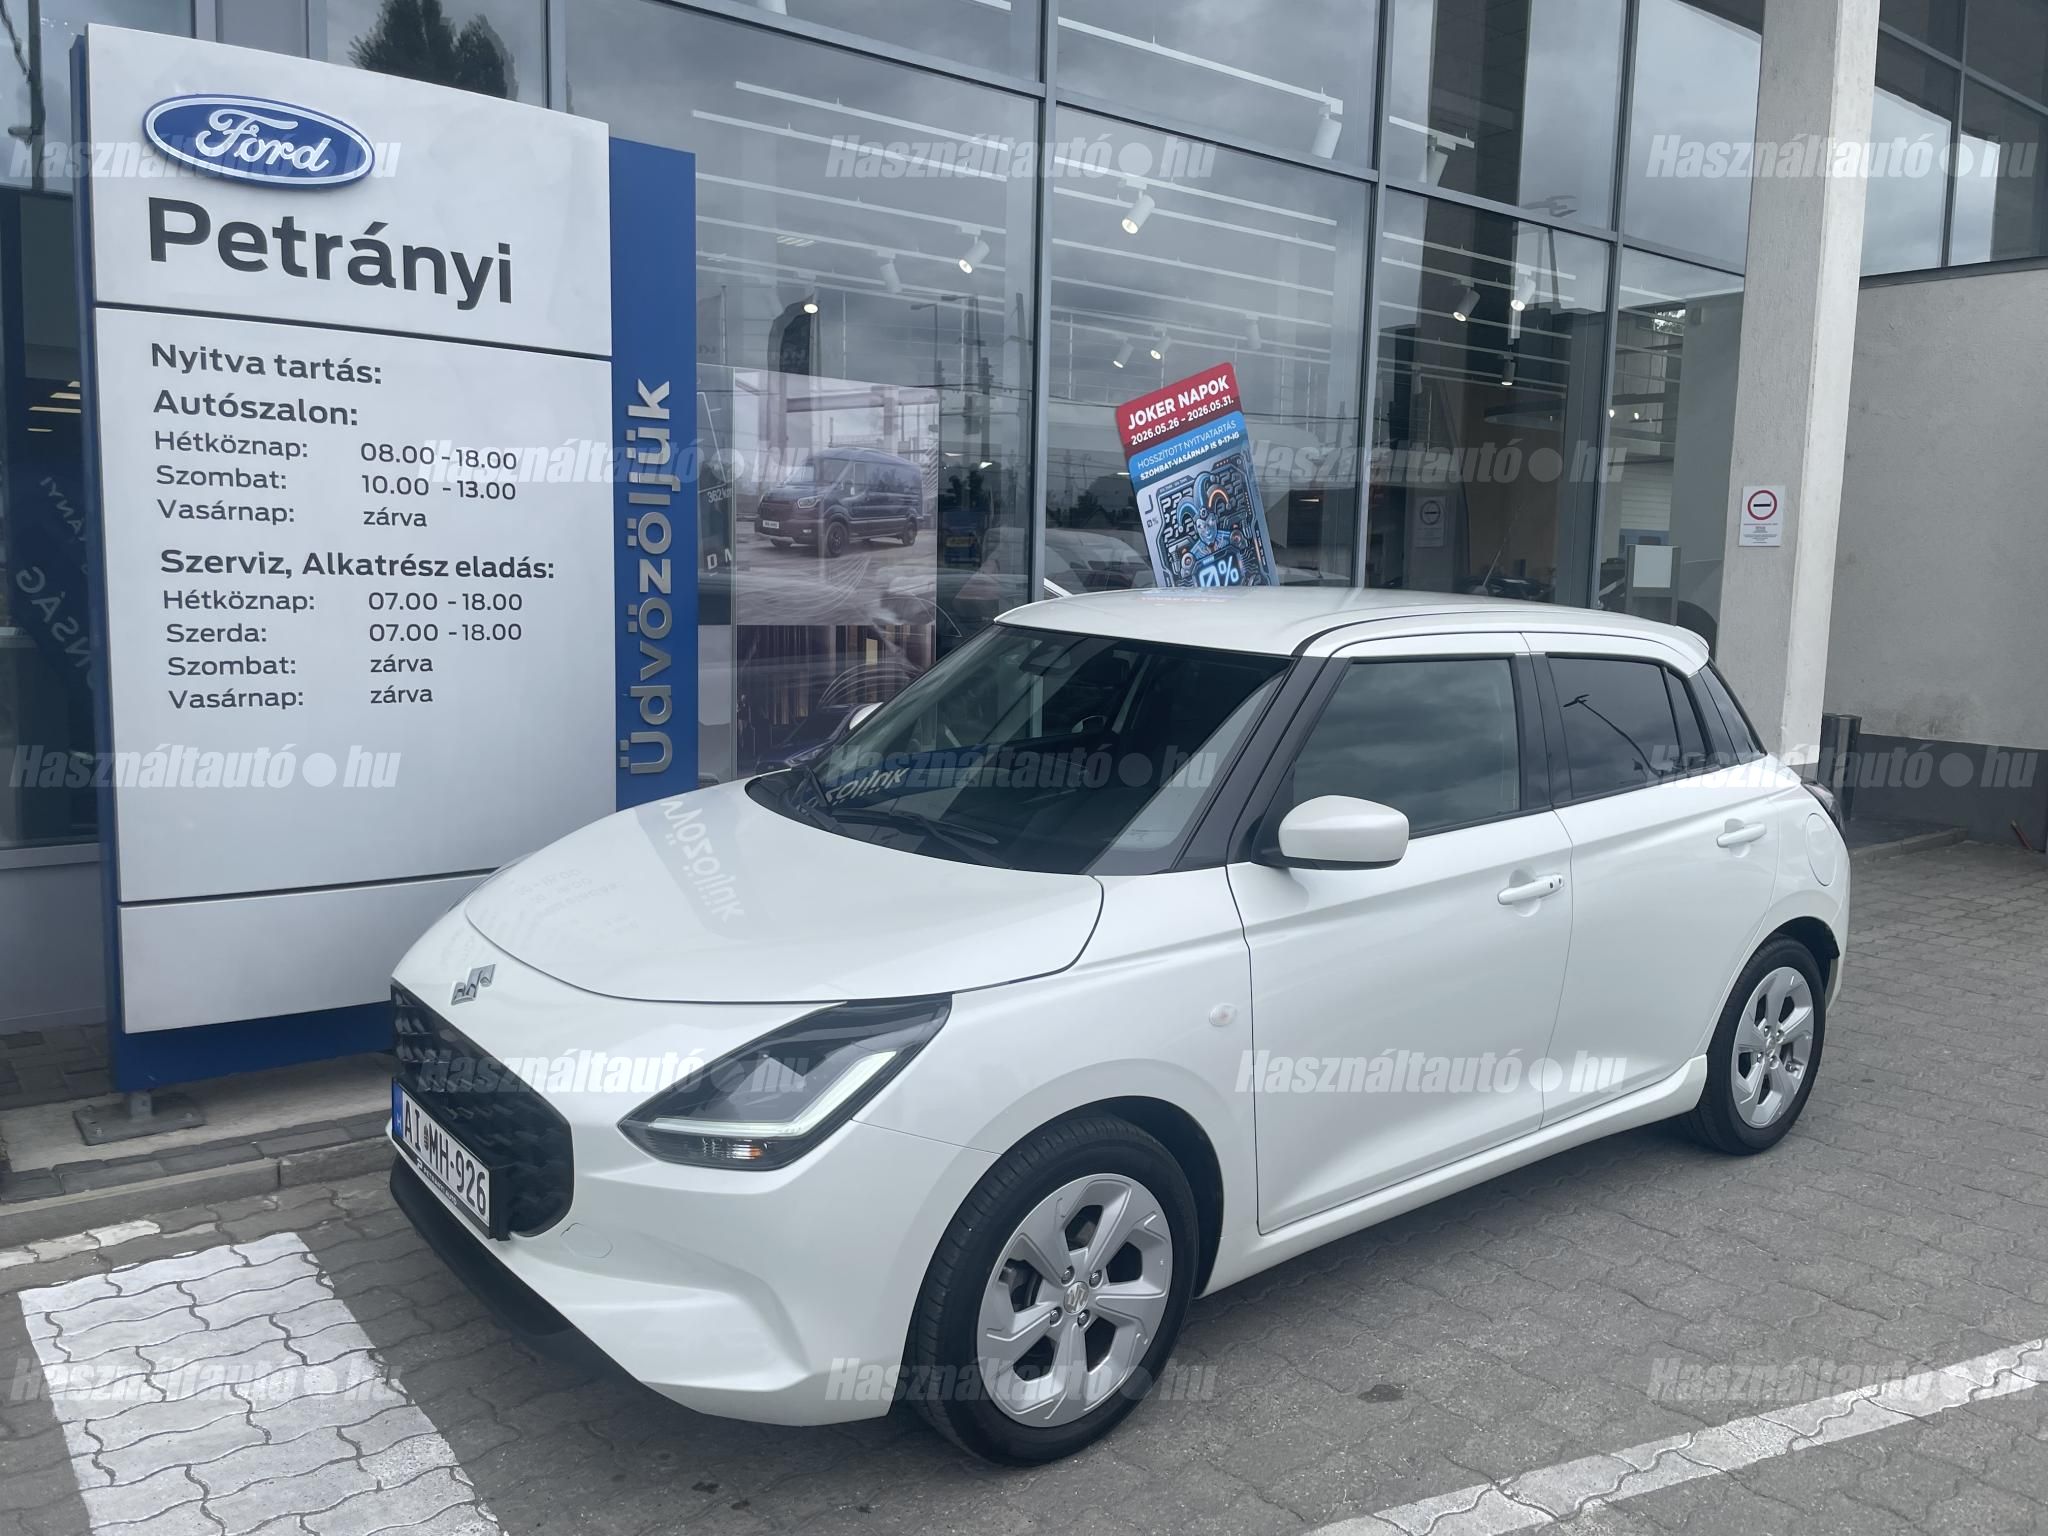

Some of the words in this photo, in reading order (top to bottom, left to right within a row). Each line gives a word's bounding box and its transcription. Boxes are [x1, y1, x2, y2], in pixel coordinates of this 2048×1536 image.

[195, 109, 331, 172] Ford
[148, 197, 512, 311] Petrányi
[151, 342, 266, 376] Nyitva
[273, 355, 382, 385] tartás:
[152, 389, 358, 426] Autószalon:
[1128, 398, 1176, 430] JOKER
[1178, 375, 1229, 408] NAPOK
[1131, 417, 1179, 445] 2026.05.26
[1187, 395, 1234, 421] 2026.05.31.
[1183, 420, 1237, 448] NYITVATARTÁS
[154, 430, 308, 460] Hétköznap:
[360, 442, 435, 465] 08.00
[1210, 440, 1218, 450] IS
[155, 465, 288, 490] Szombat:
[361, 474, 430, 496] 10.00
[156, 498, 295, 526] Vasárnap:
[363, 506, 428, 528] zárva
[160, 549, 293, 580] Szerviz,
[301, 551, 450, 577] Alkatrész
[455, 555, 554, 579] eladás:
[620, 378, 680, 775] Üdvözöljük
[163, 588, 315, 614] Hétköznap:
[368, 591, 438, 611] 07.00
[166, 622, 267, 643] Szerda:
[369, 623, 439, 642] 07.00
[167, 655, 296, 677] Szombat:
[370, 653, 434, 673] zárva
[167, 687, 304, 710] Vasárnap:
[370, 684, 434, 705] zárva
[404, 1099, 422, 1153] AI
[429, 1121, 487, 1217] MH-926
